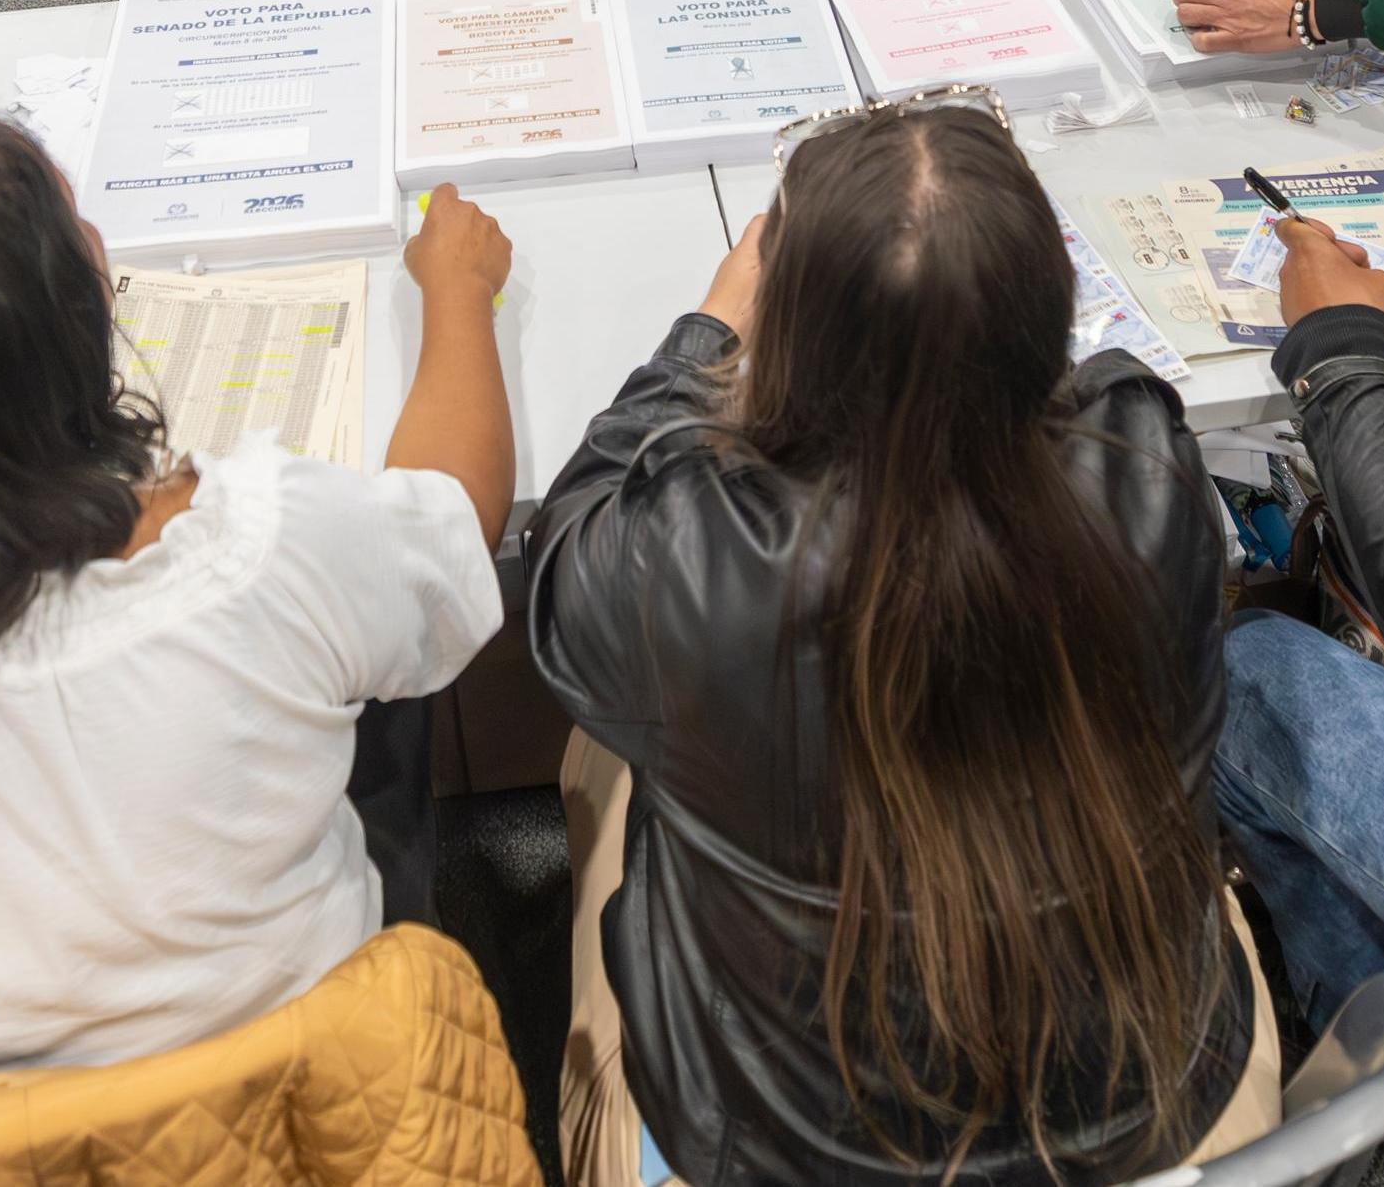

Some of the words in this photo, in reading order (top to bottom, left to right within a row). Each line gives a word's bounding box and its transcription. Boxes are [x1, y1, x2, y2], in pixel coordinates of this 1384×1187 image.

[205, 6, 252, 17] VOTO
[258, 2, 304, 12] PARA
[677, 1, 721, 12] VOTO
[132, 21, 207, 34] SENADO
[213, 19, 236, 28] DE
[242, 16, 265, 25] LA
[270, 6, 372, 23] REPÚBLICA
[438, 16, 468, 24] VOTO
[471, 13, 500, 21] PARA
[453, 15, 555, 30] REPRESENTANTES
[657, 14, 689, 24] LAS
[694, 6, 792, 20] CONSULTAS
[272, 25, 324, 35] NACIONAL
[110, 180, 158, 189] MARCAR
[186, 176, 202, 184] DE
[204, 174, 228, 182] UNA
[229, 171, 261, 180] LISTA
[263, 167, 301, 176] ANULA
[319, 162, 350, 171] VOTO
[1245, 175, 1379, 192] VERTENCIA
[1294, 187, 1358, 197] TARJETAS
[244, 194, 305, 211] 2026
